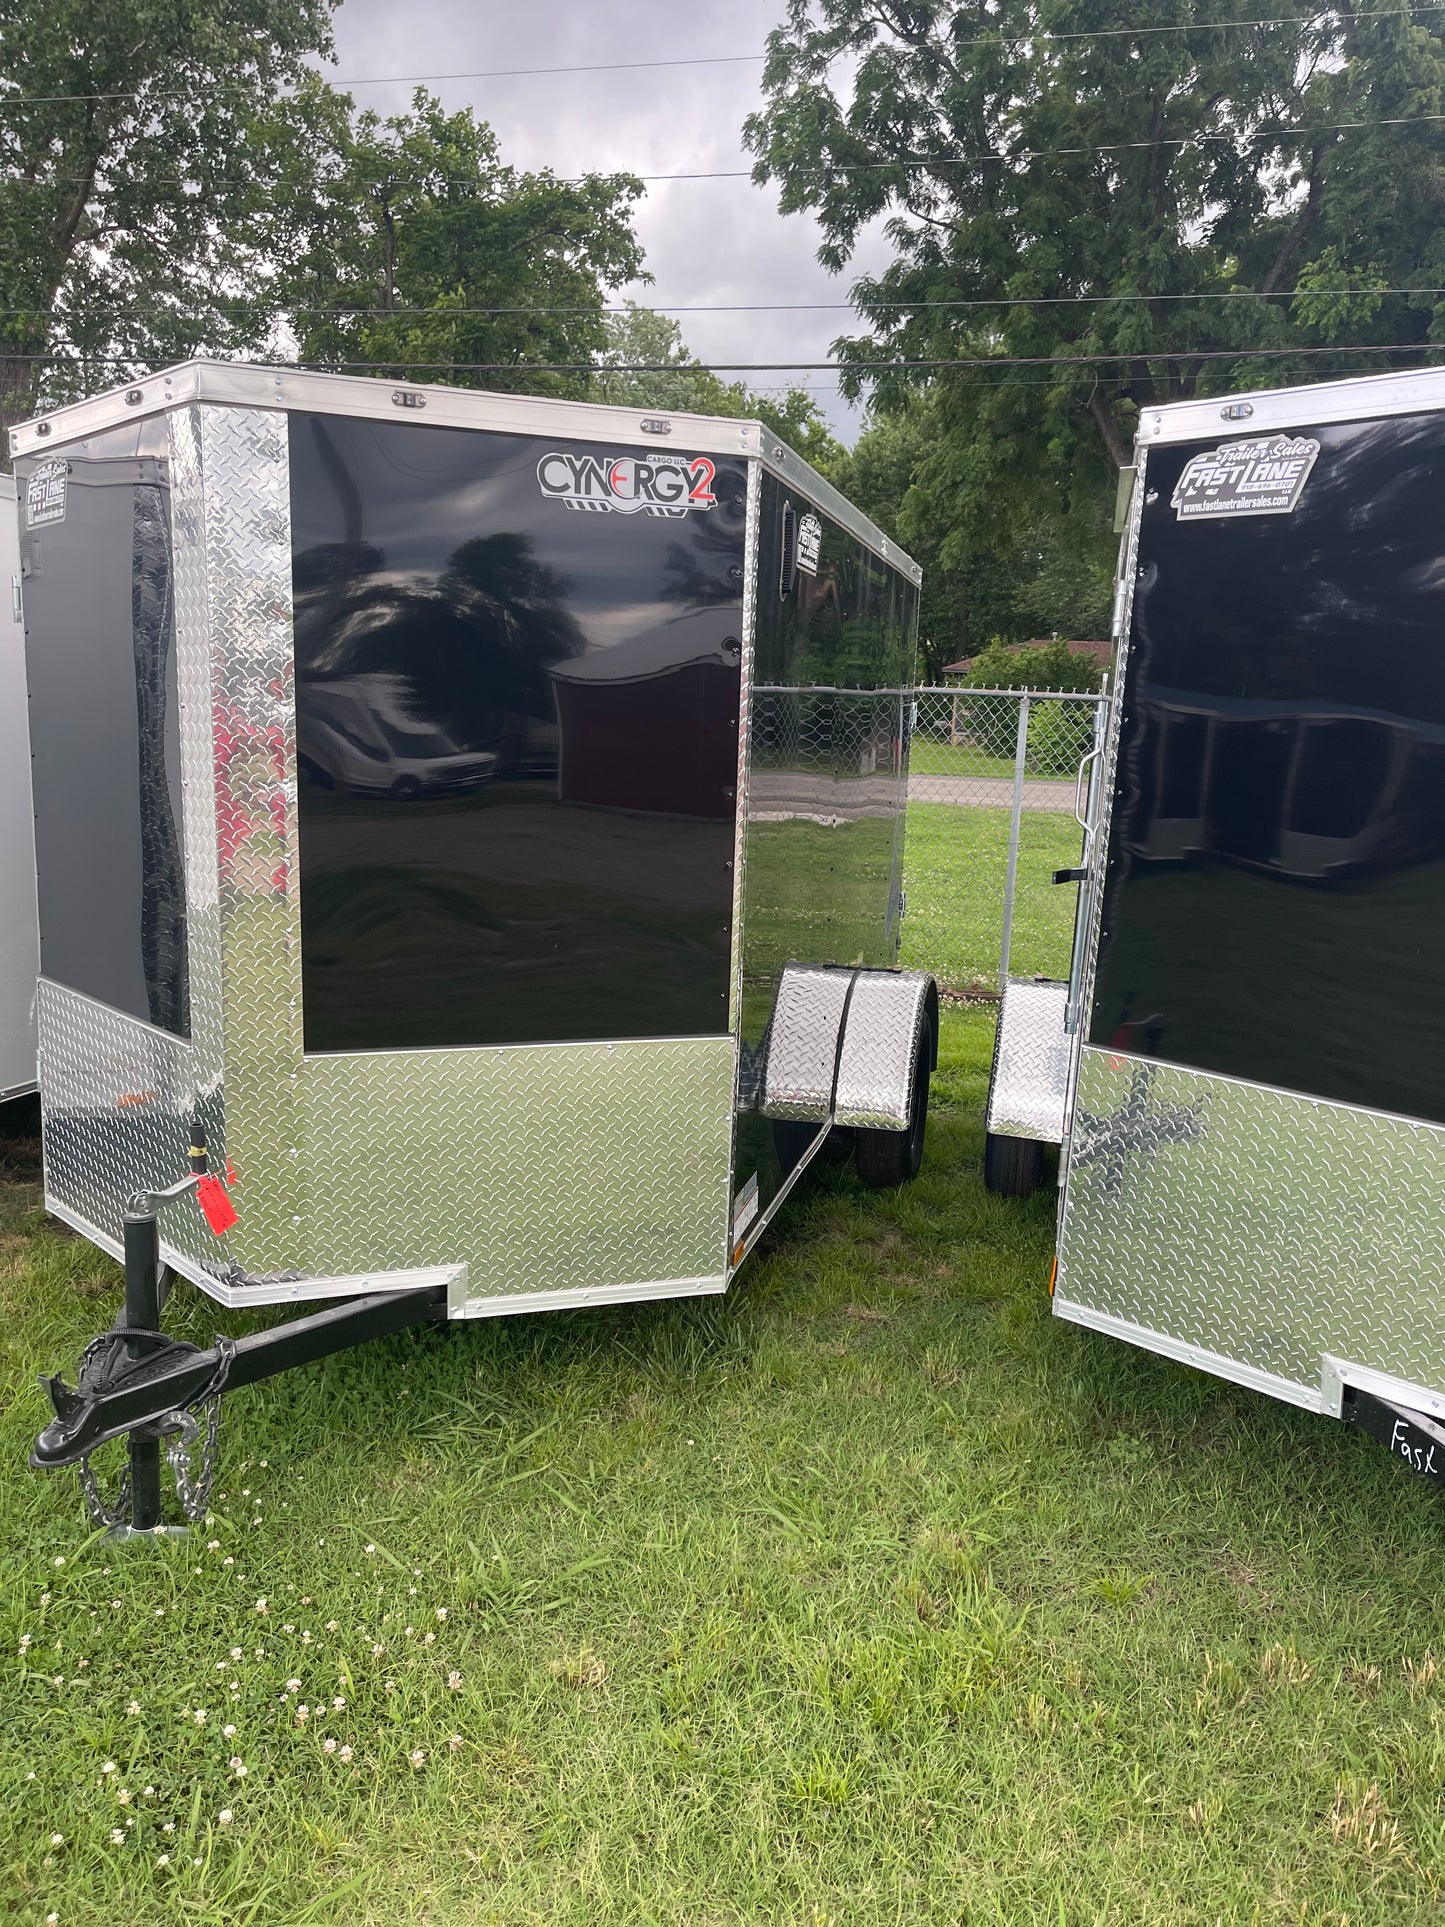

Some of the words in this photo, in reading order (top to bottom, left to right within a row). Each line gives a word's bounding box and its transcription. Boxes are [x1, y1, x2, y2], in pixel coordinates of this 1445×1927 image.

[647, 455, 673, 465] CARGO
[1219, 446, 1269, 463] Trailer
[1271, 442, 1314, 459] Sales
[1183, 495, 1289, 513] www.fastlanetrailersales.com
